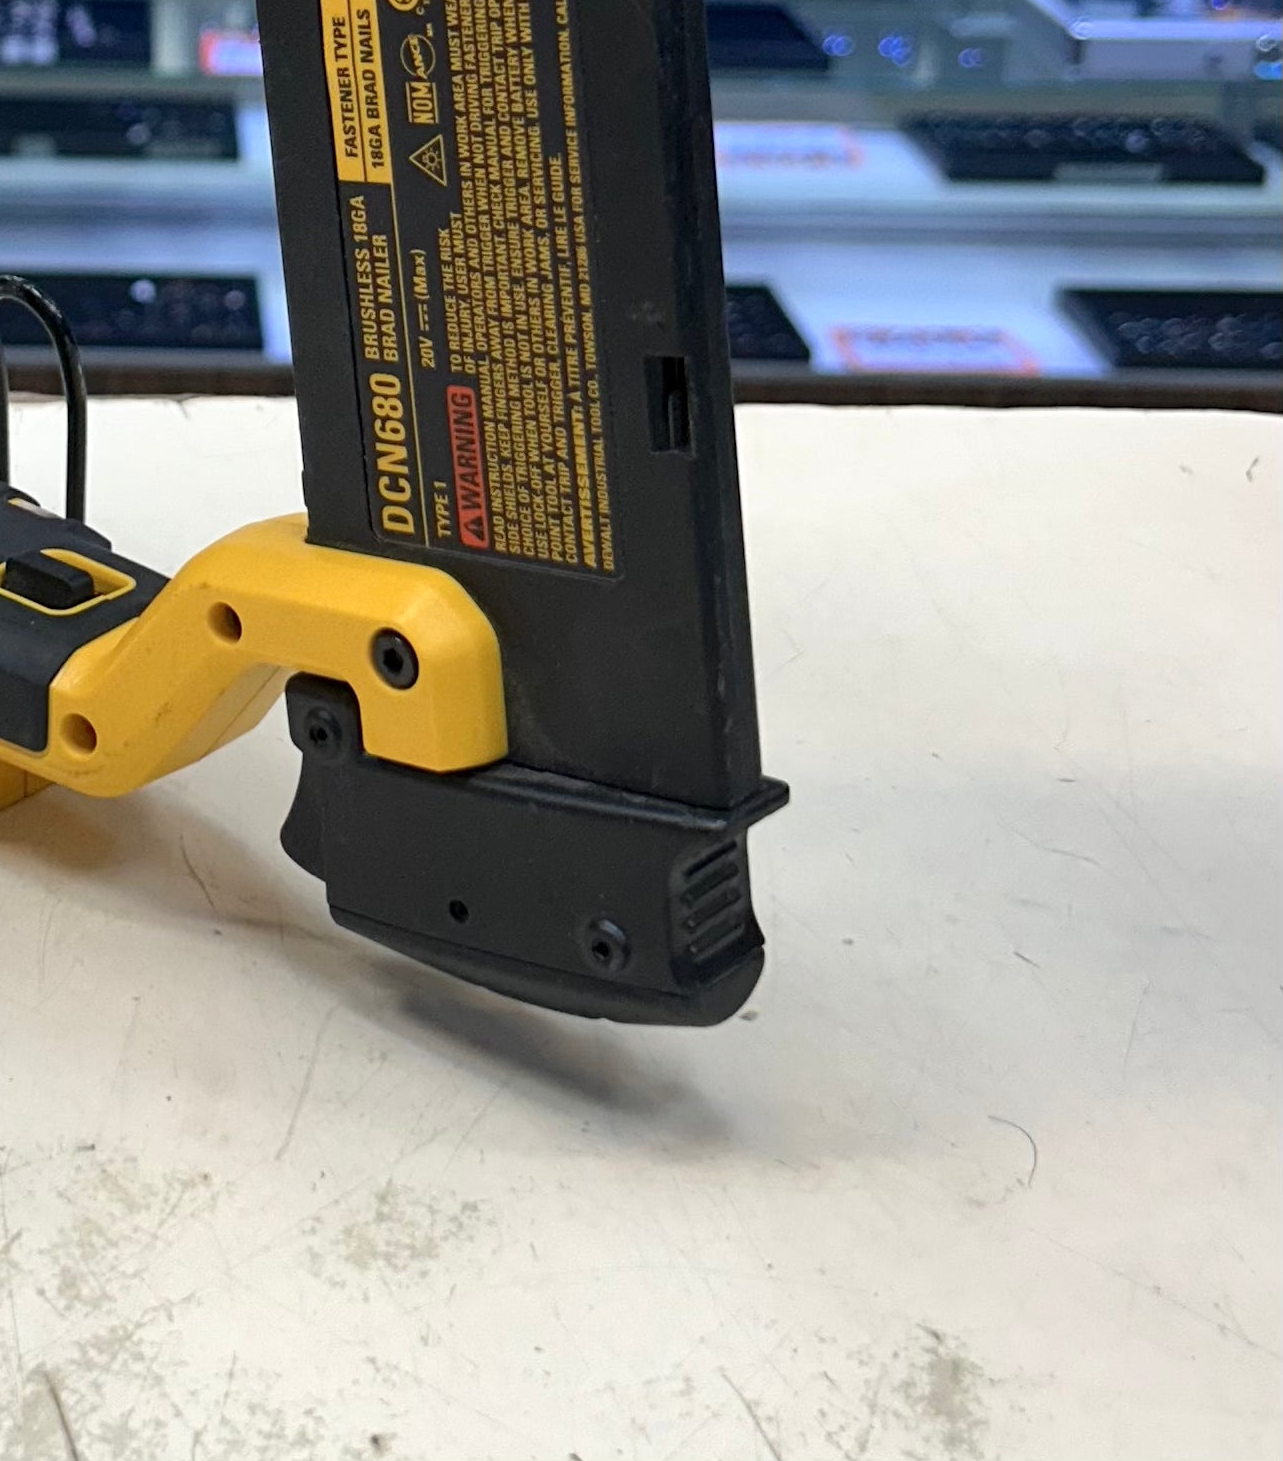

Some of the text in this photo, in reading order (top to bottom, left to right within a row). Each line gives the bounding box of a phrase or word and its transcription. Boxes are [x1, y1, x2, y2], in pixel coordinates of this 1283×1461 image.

[489, 21, 503, 53] TRIP
[517, 2, 532, 42] WITH
[447, 29, 462, 71] MUST
[521, 46, 536, 85] ONLY
[332, 17, 358, 157] FASTENER TYPE
[356, 9, 384, 168] 18GA BRAD NAILS
[451, 74, 466, 112] AREA
[481, 87, 494, 115] FOR
[492, 56, 510, 121] CONTACT
[506, 47, 524, 112] BATTERY
[410, 81, 434, 124] NOM
[465, 73, 482, 131] DRIVING
[524, 89, 539, 118] USE
[455, 115, 470, 158] WORK
[470, 135, 484, 164] NOT
[483, 118, 500, 180] MANUAL
[498, 125, 512, 157] AND
[512, 117, 528, 178] REMOVE
[565, 130, 581, 183] SERVICE
[459, 161, 471, 176] IN
[474, 167, 488, 211] WHEN
[501, 159, 517, 218] TRIGGER
[461, 180, 477, 234] OTHERS
[489, 184, 505, 229] CHECK
[535, 208, 548, 229] OR
[552, 206, 567, 223] LE
[570, 186, 583, 212] FOR
[449, 211, 465, 253] MUST
[478, 214, 494, 271] TRIGGER
[507, 222, 523, 277] ENSURE
[554, 226, 570, 258] LIRE
[573, 214, 586, 243] USA
[466, 237, 480, 269] AND
[522, 228, 537, 273] WORK
[349, 195, 379, 359] BRUSHLESS 18GA
[454, 257, 469, 294] USER
[483, 275, 498, 315] FROM
[526, 277, 539, 293] IN
[579, 283, 592, 306] MD
[371, 234, 399, 361] BRAD NAILER
[410, 249, 435, 368] 20V (Max)
[438, 228, 462, 372] TO REDUCE THE RISK
[469, 271, 488, 351] OPERATORS
[541, 283, 558, 354] CLEARING
[487, 318, 502, 360] AWAY
[515, 314, 528, 330] IN
[528, 297, 544, 353] OTHERS
[462, 355, 476, 374] OF
[503, 338, 520, 397] METHOD
[516, 332, 531, 362] NOT
[533, 357, 546, 377] OR
[565, 347, 580, 386] TITRE
[491, 363, 508, 420] FINGERS
[522, 383, 536, 416] TOOL
[535, 380, 552, 452] YOURSELF
[589, 400, 602, 433] TOOL
[370, 373, 414, 532] DCN680
[451, 393, 481, 509] WARNING
[497, 422, 511, 457] KEEP
[509, 400, 527, 482] TRIGGERING
[525, 419, 540, 462] WHEN
[554, 426, 568, 460] AND
[484, 421, 503, 512] INSTRUCTION
[542, 455, 555, 475] AT
[557, 461, 571, 493] TRIP
[592, 438, 609, 514] INDUSTRIAL
[433, 480, 451, 537] TYPE 1
[516, 485, 530, 503] OF
[529, 465, 546, 529] LOCK-OFF
[544, 479, 558, 513] TOOL
[492, 515, 506, 551] READ
[506, 522, 520, 554] SIDE
[519, 506, 534, 556] CHOICE
[535, 531, 549, 559] USE
[547, 516, 563, 561] POINT
[560, 497, 577, 563] CONTACT
[599, 516, 614, 570] DEWALT
